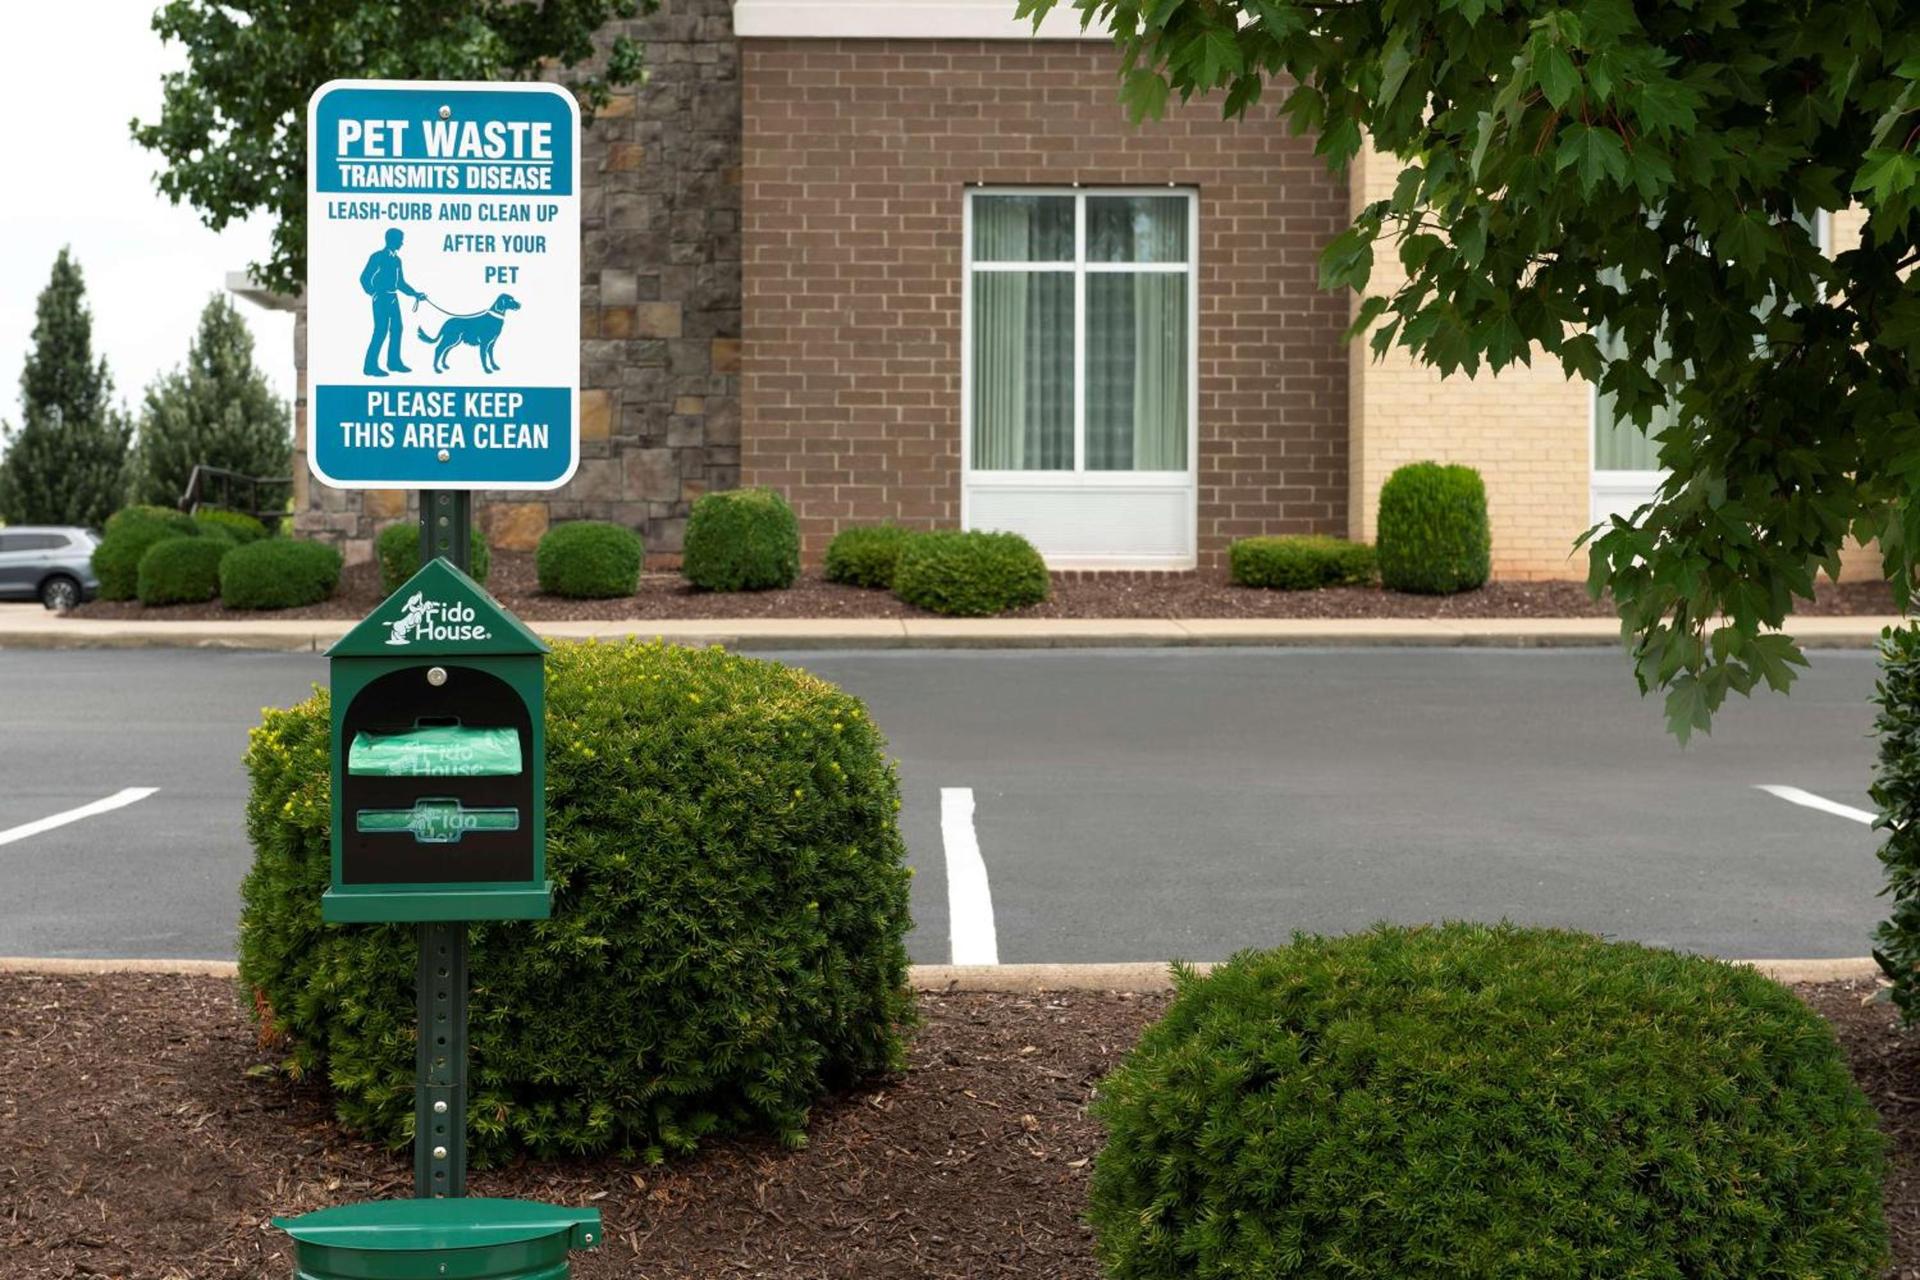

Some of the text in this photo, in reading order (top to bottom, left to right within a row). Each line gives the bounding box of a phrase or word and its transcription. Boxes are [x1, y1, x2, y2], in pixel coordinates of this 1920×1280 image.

[338, 119, 553, 159] PET WASTE
[338, 164, 552, 190] TRANSMITS DISEASE
[328, 201, 559, 222] LEASH-CURB AND CLEAN UP
[443, 234, 546, 253] AFTER YOUR
[485, 266, 519, 284] PET
[367, 391, 523, 418] PLEASE KEEP
[339, 422, 549, 449] THIS AREA CLEAN
